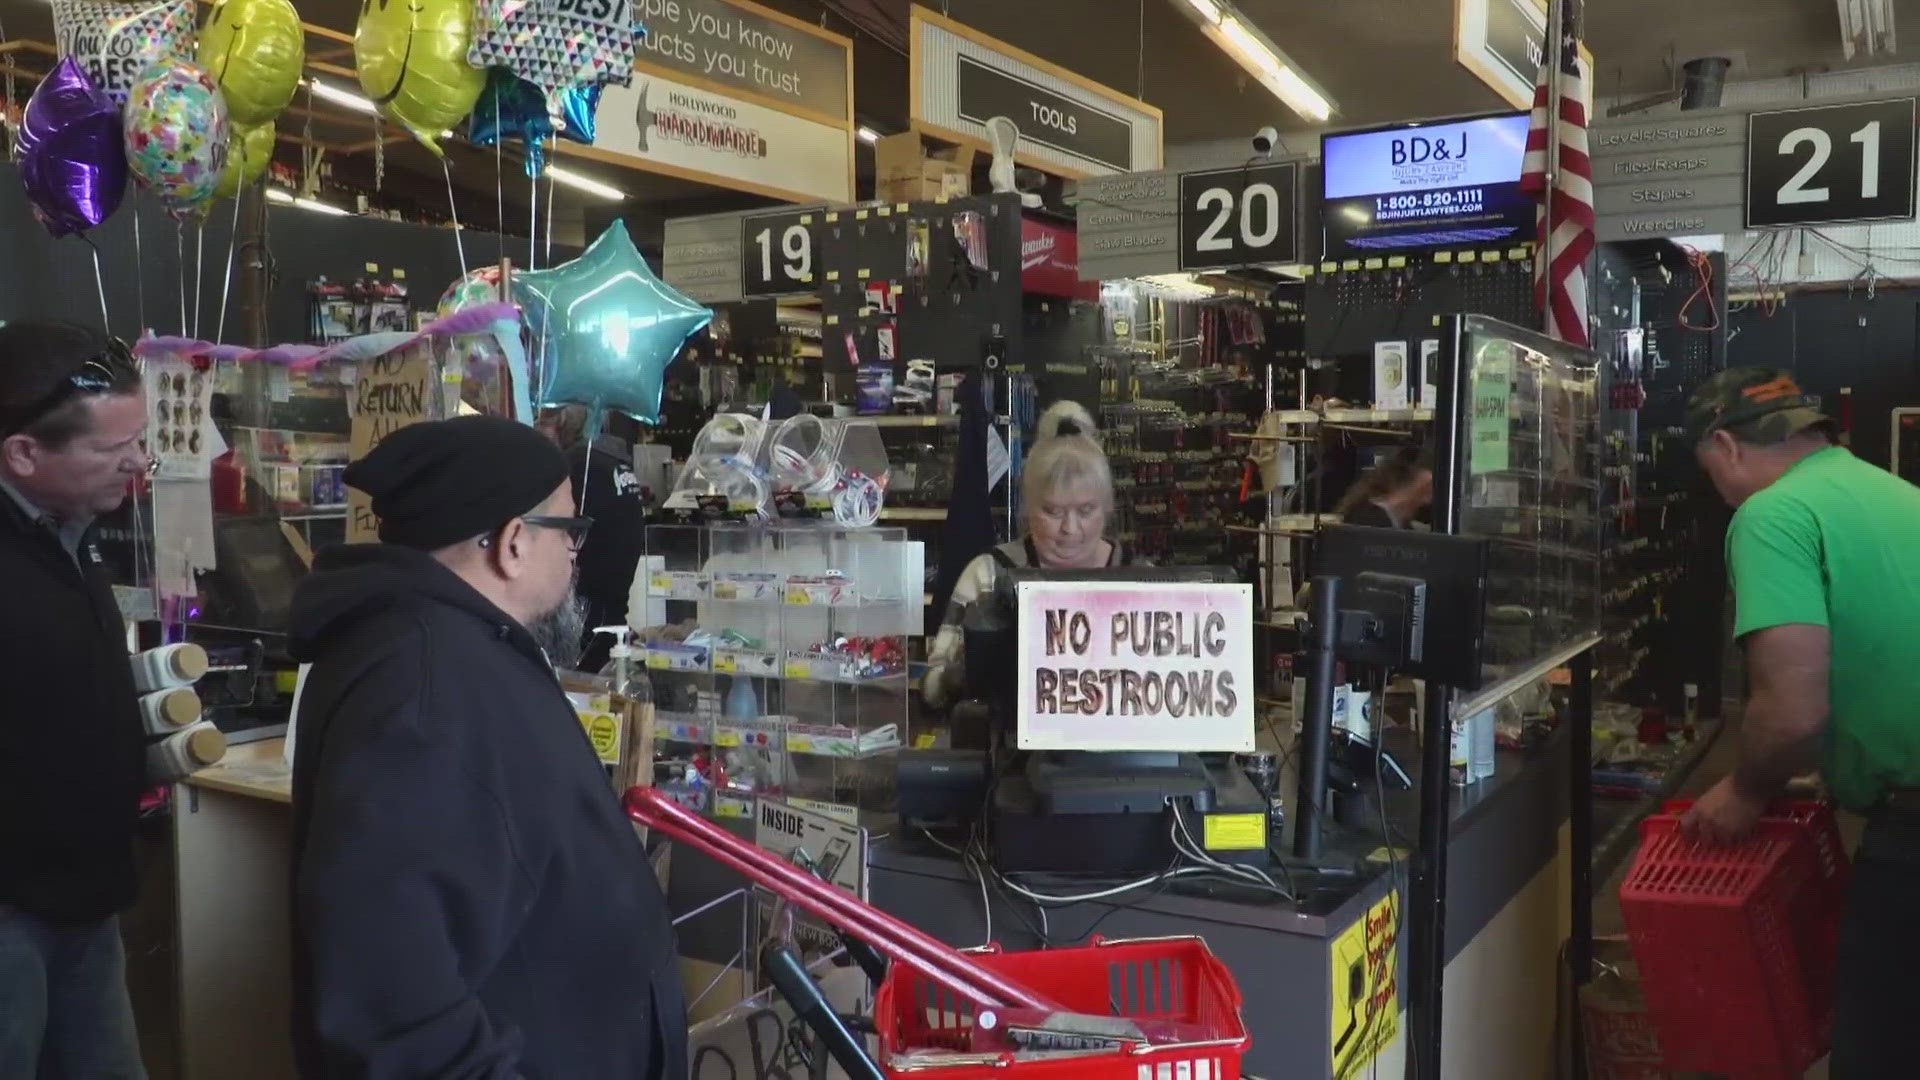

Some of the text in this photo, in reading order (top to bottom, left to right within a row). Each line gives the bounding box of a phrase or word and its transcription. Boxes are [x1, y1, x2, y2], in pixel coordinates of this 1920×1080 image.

[687, 8, 731, 40] you
[739, 20, 793, 61] know
[89, 58, 139, 91] BES
[704, 48, 746, 78] you
[753, 59, 800, 96] trust
[669, 91, 737, 120] HOLLYWOOD
[1030, 101, 1078, 135] TOOLS
[656, 107, 760, 157] HARDWARE
[1391, 131, 1467, 166] BD&J
[1597, 124, 1727, 146] Levels/Squares
[1614, 157, 1709, 175] Files/Rasps
[1777, 121, 1880, 205] 21
[1100, 176, 1166, 192] Power Tool
[1376, 189, 1483, 211] 1-800-820-1111
[1631, 188, 1695, 205] Staples
[1089, 213, 1133, 225] Cement
[1196, 182, 1279, 252] 20
[1623, 217, 1705, 234] Wrenches
[755, 225, 812, 282] 19
[356, 377, 424, 416] RETURN
[1045, 609, 1226, 658] NO PUBLIC
[1036, 667, 1237, 718] RESTROOMS
[762, 804, 804, 838] INSIDE
[1367, 905, 1391, 941] Smile
